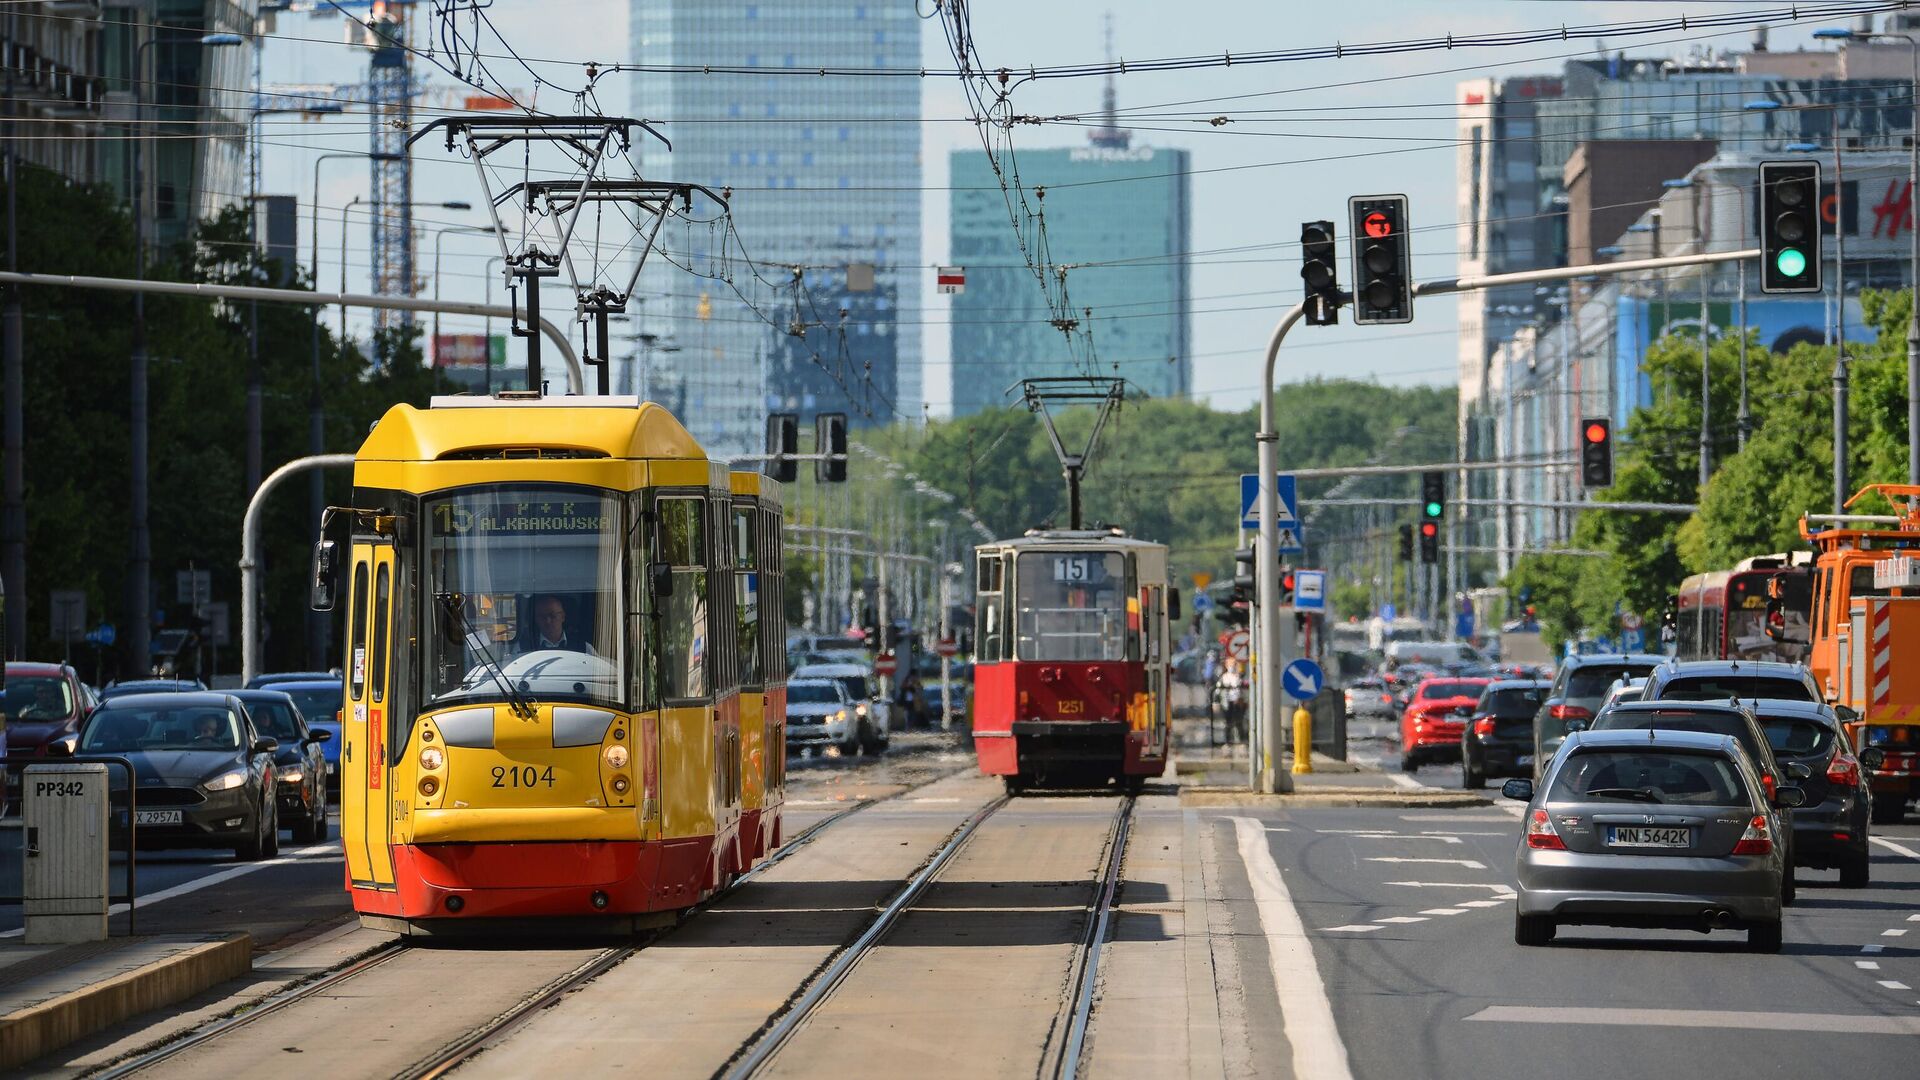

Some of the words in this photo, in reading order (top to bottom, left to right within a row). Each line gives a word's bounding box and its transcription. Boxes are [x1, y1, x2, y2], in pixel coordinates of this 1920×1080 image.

[1060, 559, 1083, 580] 15
[1058, 700, 1084, 713] 1251
[491, 765, 556, 788] 2104
[36, 781, 84, 797] PP342
[146, 810, 180, 823] 2957A
[1617, 828, 1639, 843] WN
[1643, 829, 1688, 844] 5642K
